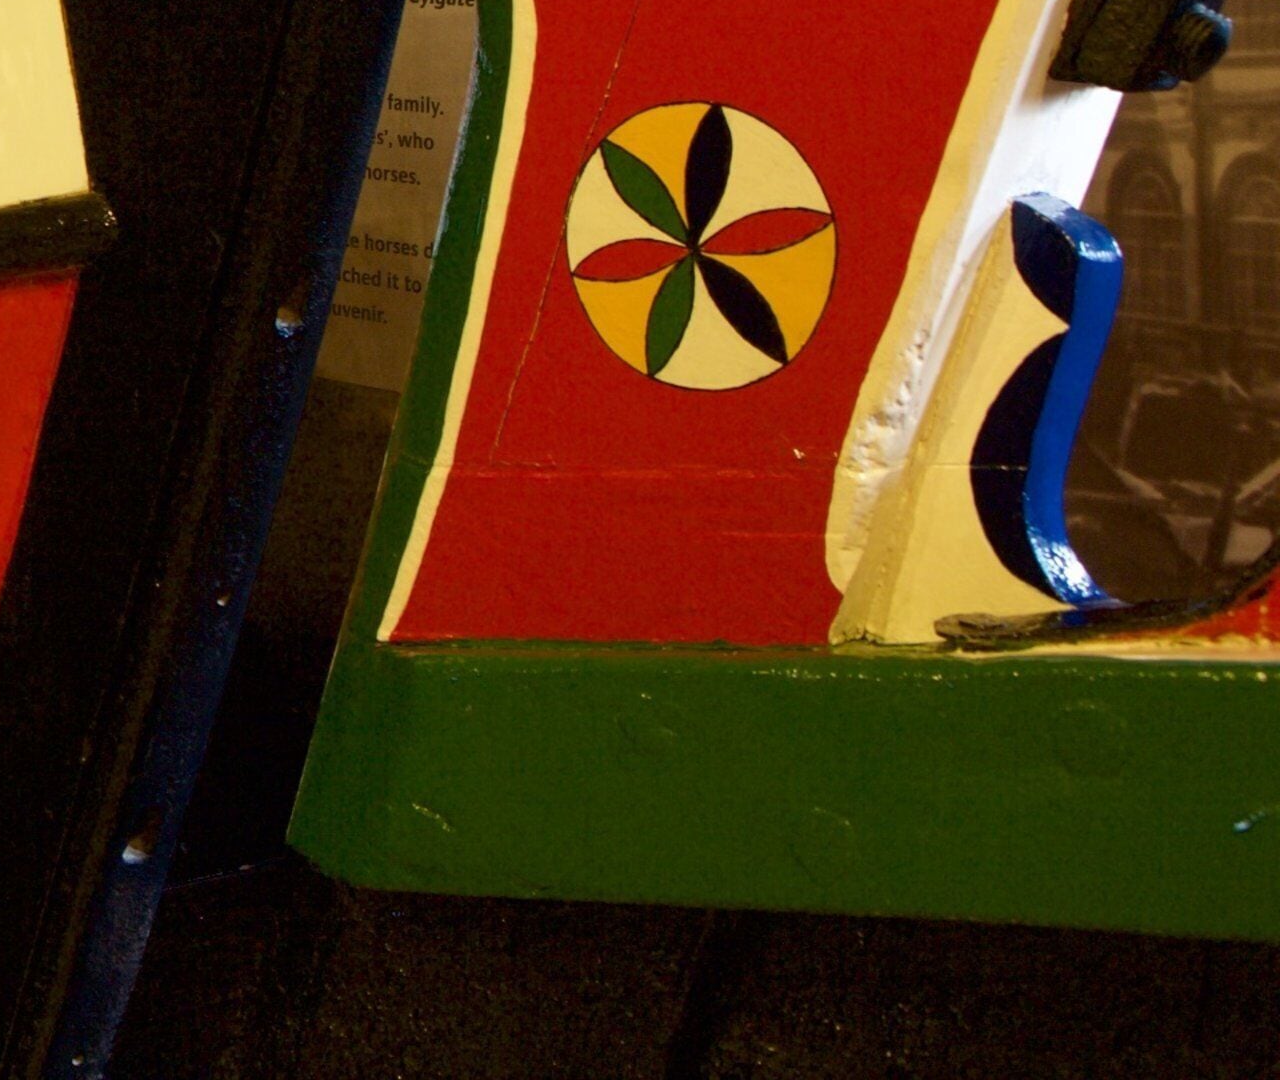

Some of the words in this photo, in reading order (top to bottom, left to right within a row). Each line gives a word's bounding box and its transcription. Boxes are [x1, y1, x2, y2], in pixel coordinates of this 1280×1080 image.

[388, 94, 444, 118] family.
[397, 132, 434, 150] who
[365, 233, 418, 255] horses
[339, 270, 381, 288] ched
[387, 272, 399, 290] it
[405, 276, 422, 293] to
